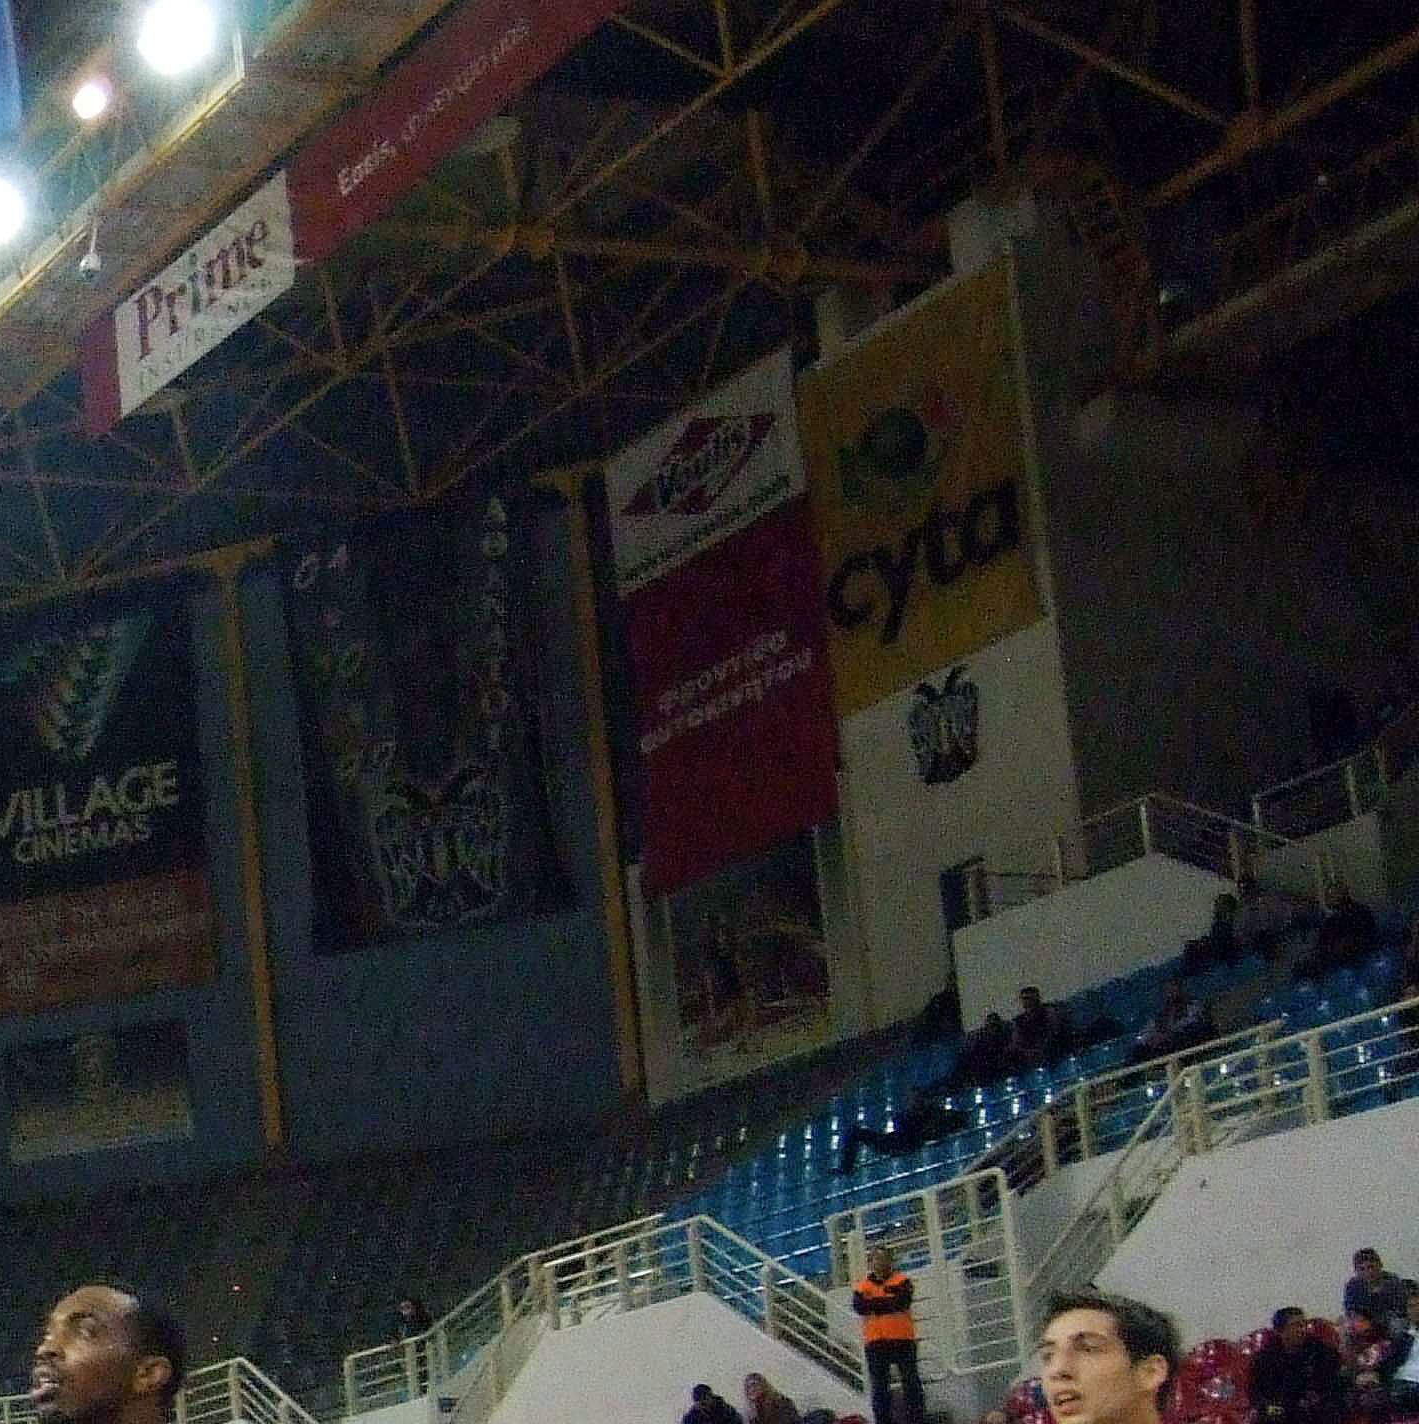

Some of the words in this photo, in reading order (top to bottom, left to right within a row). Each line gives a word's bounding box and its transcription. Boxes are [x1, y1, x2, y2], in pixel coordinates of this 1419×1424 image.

[135, 219, 270, 363] Prime
[824, 480, 1021, 646] cyta
[11, 814, 153, 865] CINEMAS
